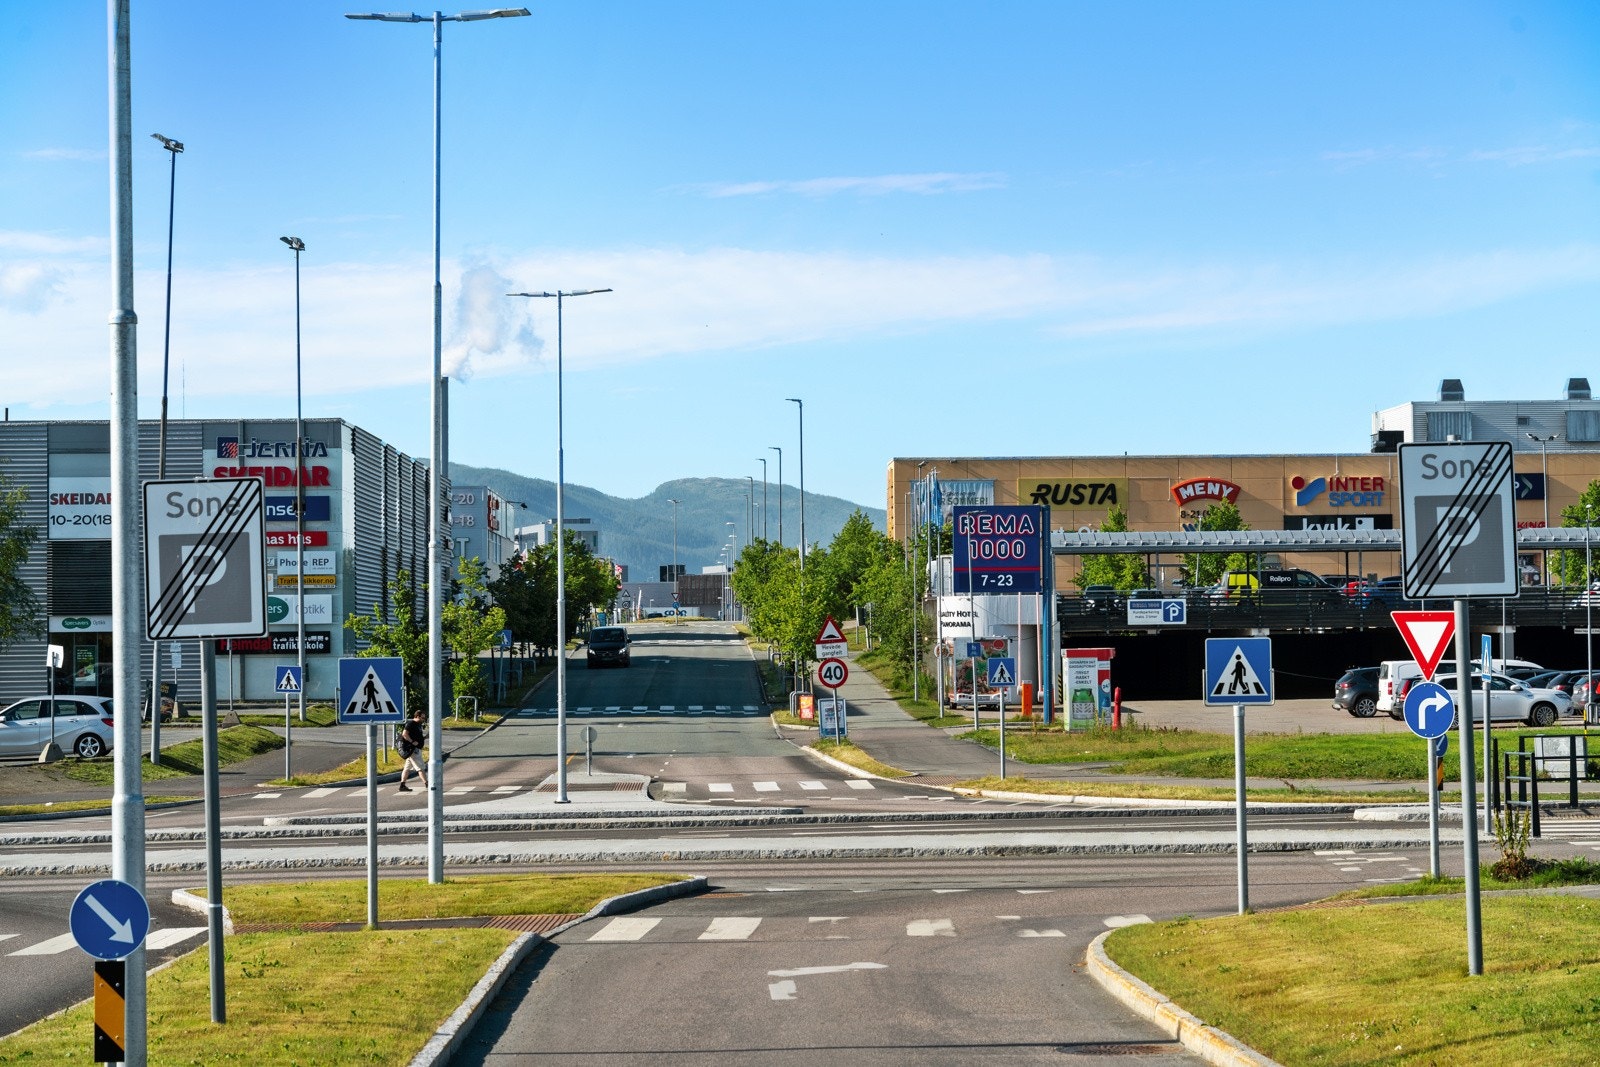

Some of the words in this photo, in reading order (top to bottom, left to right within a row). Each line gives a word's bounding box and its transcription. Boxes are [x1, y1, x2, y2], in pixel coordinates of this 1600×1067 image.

[1421, 453, 1493, 481] Sone
[1178, 482, 1234, 500] MENY
[1329, 476, 1385, 492] INTER
[1029, 483, 1118, 506] RUSTA
[1328, 491, 1385, 507] SPORT
[166, 491, 241, 519] Sone
[959, 514, 1035, 535] REMA
[968, 539, 1026, 560] 1000
[280, 558, 308, 566] Phoe
[312, 558, 329, 567] REP
[981, 574, 1014, 587] 7-23
[823, 665, 844, 680] 40
